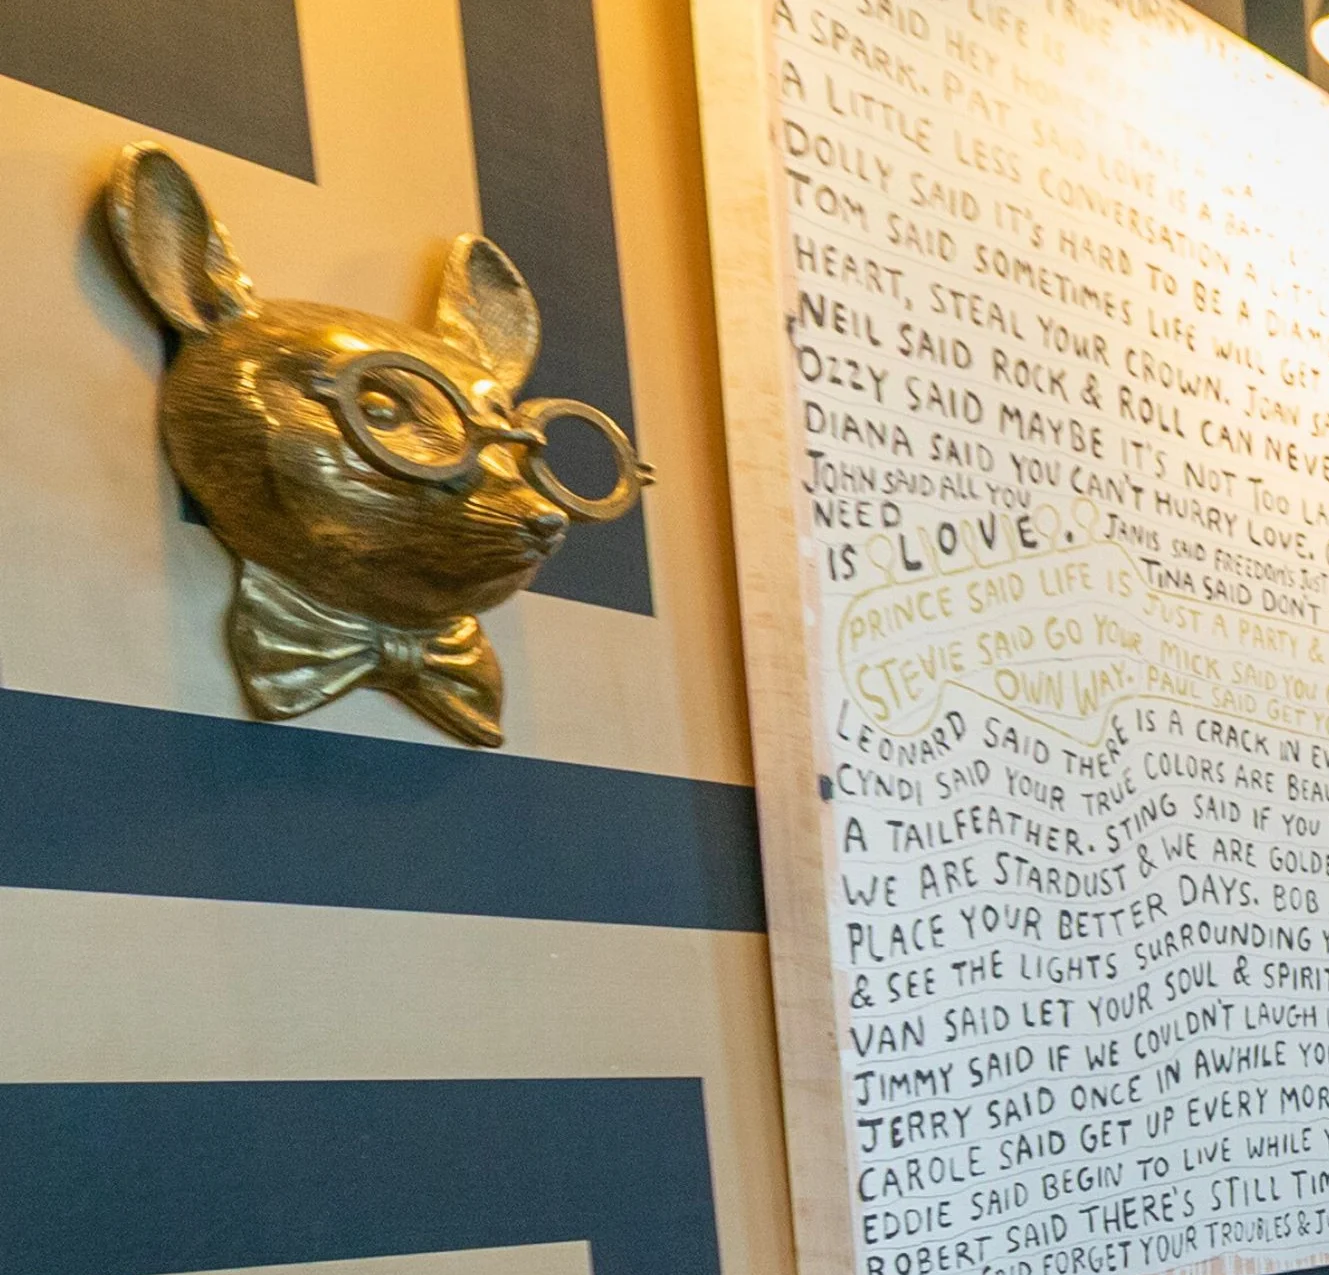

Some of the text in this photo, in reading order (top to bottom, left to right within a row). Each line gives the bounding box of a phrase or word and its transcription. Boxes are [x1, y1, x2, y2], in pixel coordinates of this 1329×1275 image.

[798, 291, 881, 347] NEIL
[898, 323, 972, 370] SAID
[993, 348, 1068, 402] ROCK
[1082, 373, 1101, 410] &
[1119, 385, 1185, 438] ROLL
[1200, 419, 1252, 455] CAN
[931, 283, 1024, 341] STEAL
[1037, 316, 1110, 367] YOUR
[849, 1017, 924, 1058] VAN
[944, 1004, 1010, 1043] SAID
[1022, 998, 1073, 1028] LET
[1087, 981, 1154, 1026] YOUR
[1164, 962, 1218, 1002] SOUL
[1233, 954, 1251, 986] &
[854, 1063, 953, 1106] JIMMY
[968, 1045, 1034, 1088] SAID
[1048, 1044, 1070, 1072] IF
[1085, 1040, 1119, 1071] WE
[1245, 1002, 1317, 1031] LAUGH
[857, 1107, 971, 1154] JERRY
[986, 1086, 1055, 1130] SAID
[1071, 1074, 1142, 1112] ONCE
[1156, 1060, 1181, 1093] IN
[1195, 1040, 1286, 1079] AWHILE
[857, 1145, 985, 1203] CAROLE
[999, 1130, 1066, 1171] SAID
[1080, 1119, 1132, 1154] GET
[1146, 1105, 1175, 1139] UP
[1187, 1087, 1268, 1128] EVERY
[863, 1200, 952, 1245] EDDIE
[970, 1181, 1027, 1222] SAID
[1041, 1162, 1123, 1201] BEGIN
[1136, 1156, 1170, 1181] TO
[1183, 1136, 1231, 1172] LIVE
[1246, 1126, 1312, 1160] WHILE
[1006, 1213, 1068, 1254] SAID
[1078, 1186, 1195, 1234] THERE'S
[1211, 1175, 1281, 1212] STILL
[1139, 1224, 1198, 1266] YOUR
[1204, 1212, 1292, 1248] TROUBLES
[1297, 1209, 1311, 1237] &
